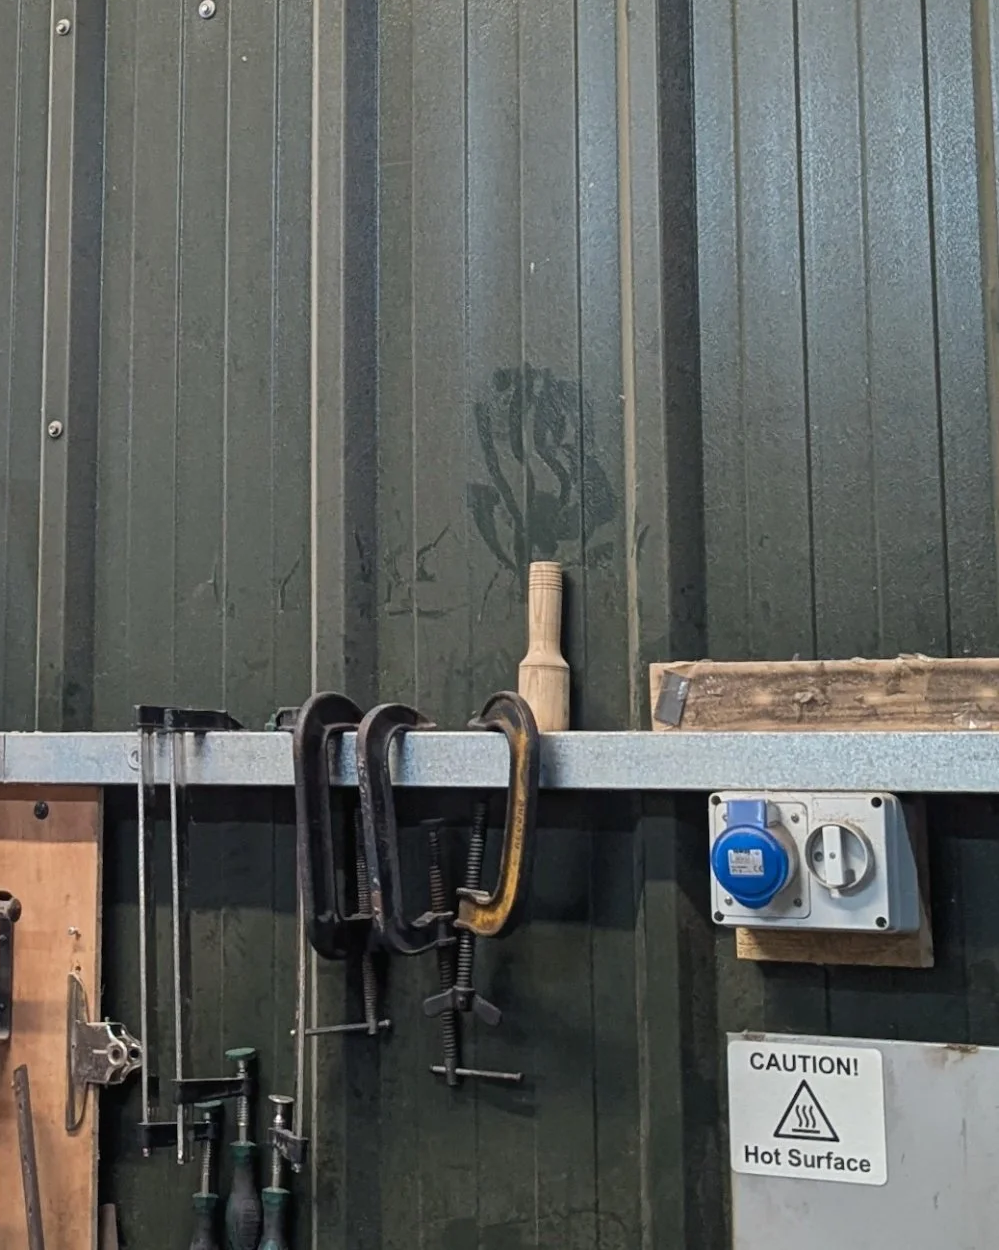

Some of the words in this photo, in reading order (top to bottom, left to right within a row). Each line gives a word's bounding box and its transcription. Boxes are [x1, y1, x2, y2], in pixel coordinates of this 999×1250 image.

[750, 1052, 859, 1077] CAUTION!
[744, 1145, 782, 1166] Hot
[788, 1148, 872, 1173] Surface
